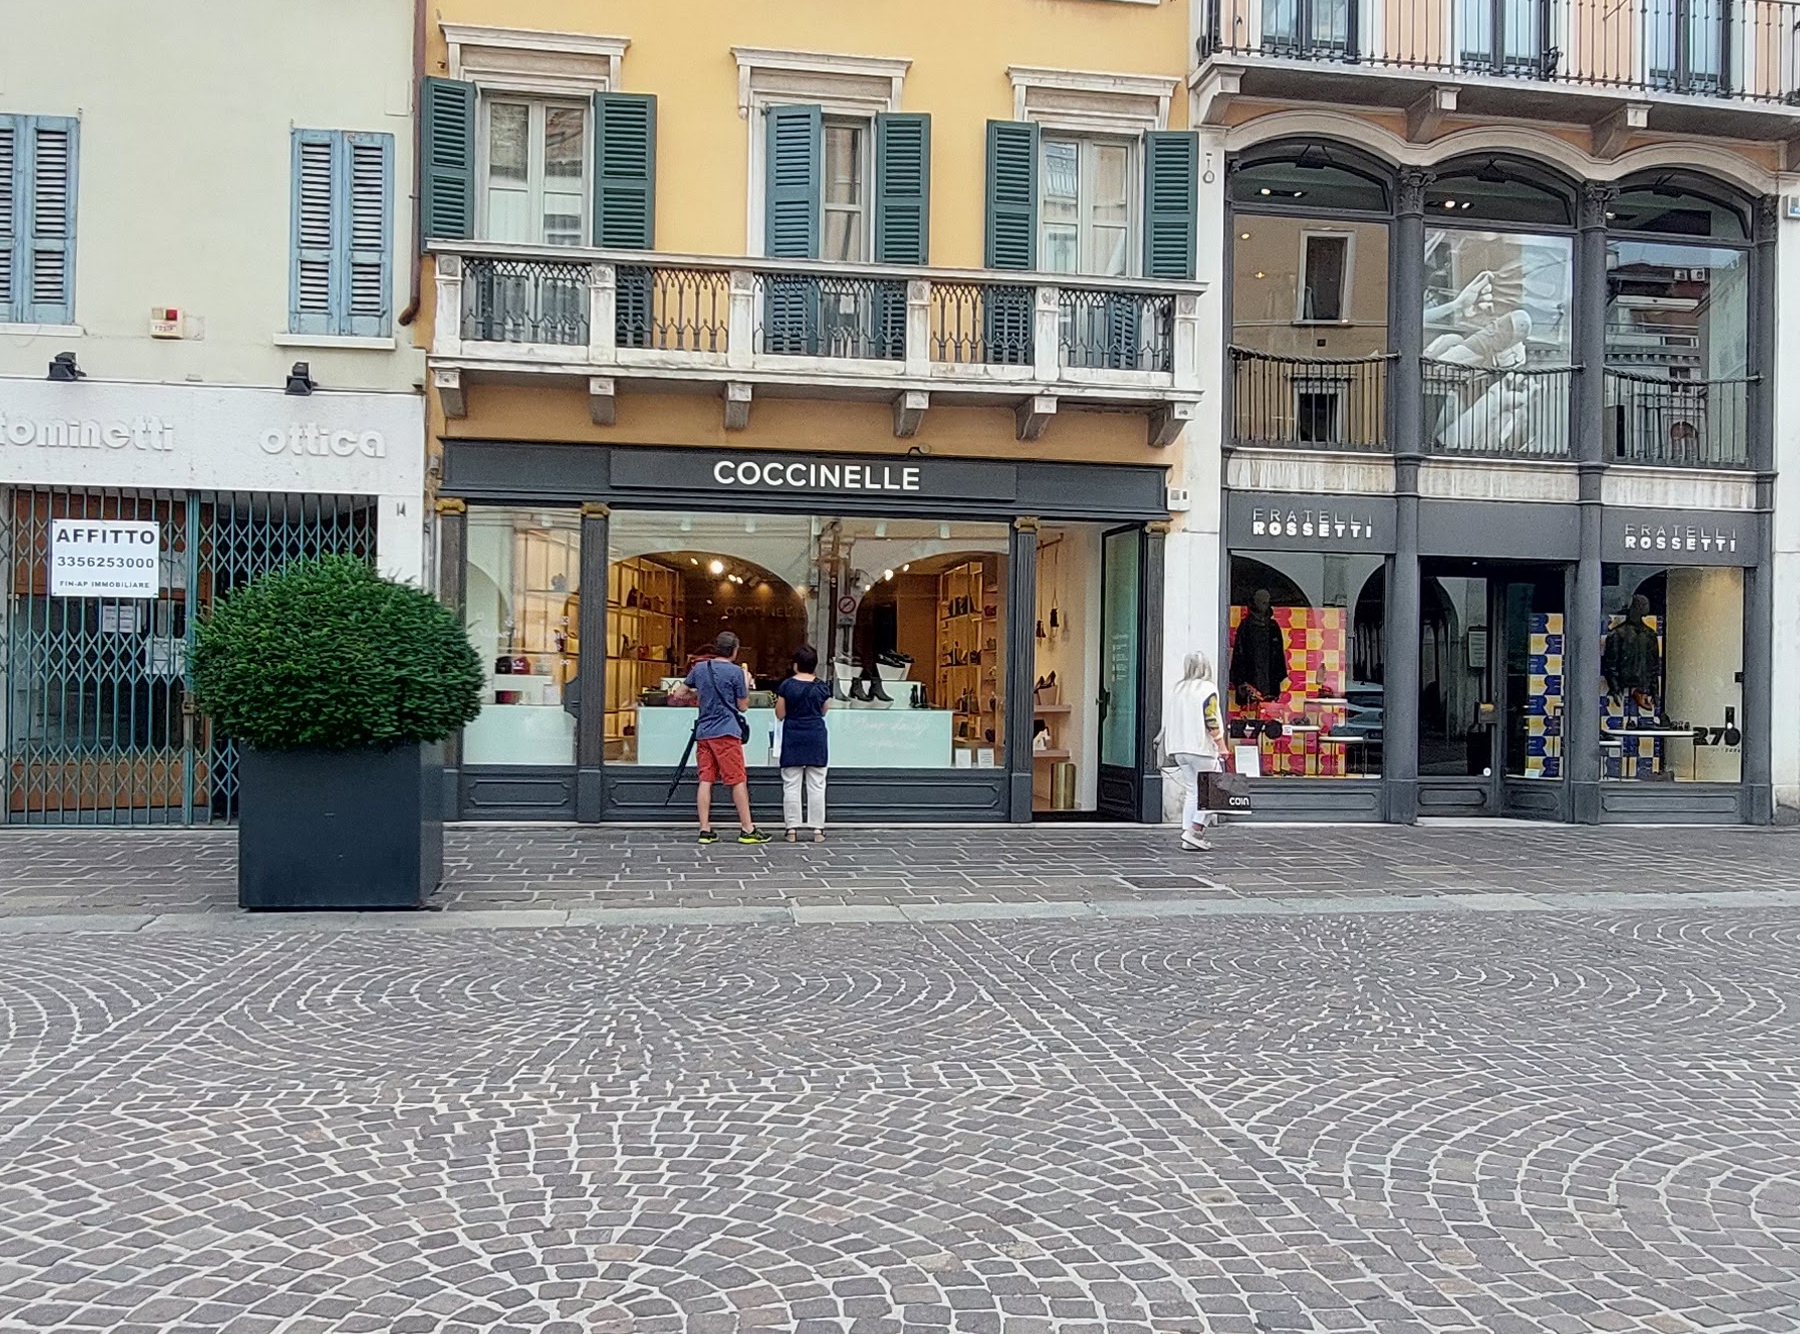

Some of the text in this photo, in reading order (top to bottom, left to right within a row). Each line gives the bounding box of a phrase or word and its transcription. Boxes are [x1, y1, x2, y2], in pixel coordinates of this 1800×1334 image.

[259, 422, 386, 458] ottica
[713, 460, 921, 491] COCCINELLE
[1252, 508, 1373, 525] FRATELLI
[56, 528, 155, 545] AFFITTO
[1252, 521, 1373, 539] ROSSETTI
[1624, 523, 1736, 539] FRATELLI
[1624, 535, 1736, 552] ROSSETTI
[57, 556, 154, 569] 3356253000
